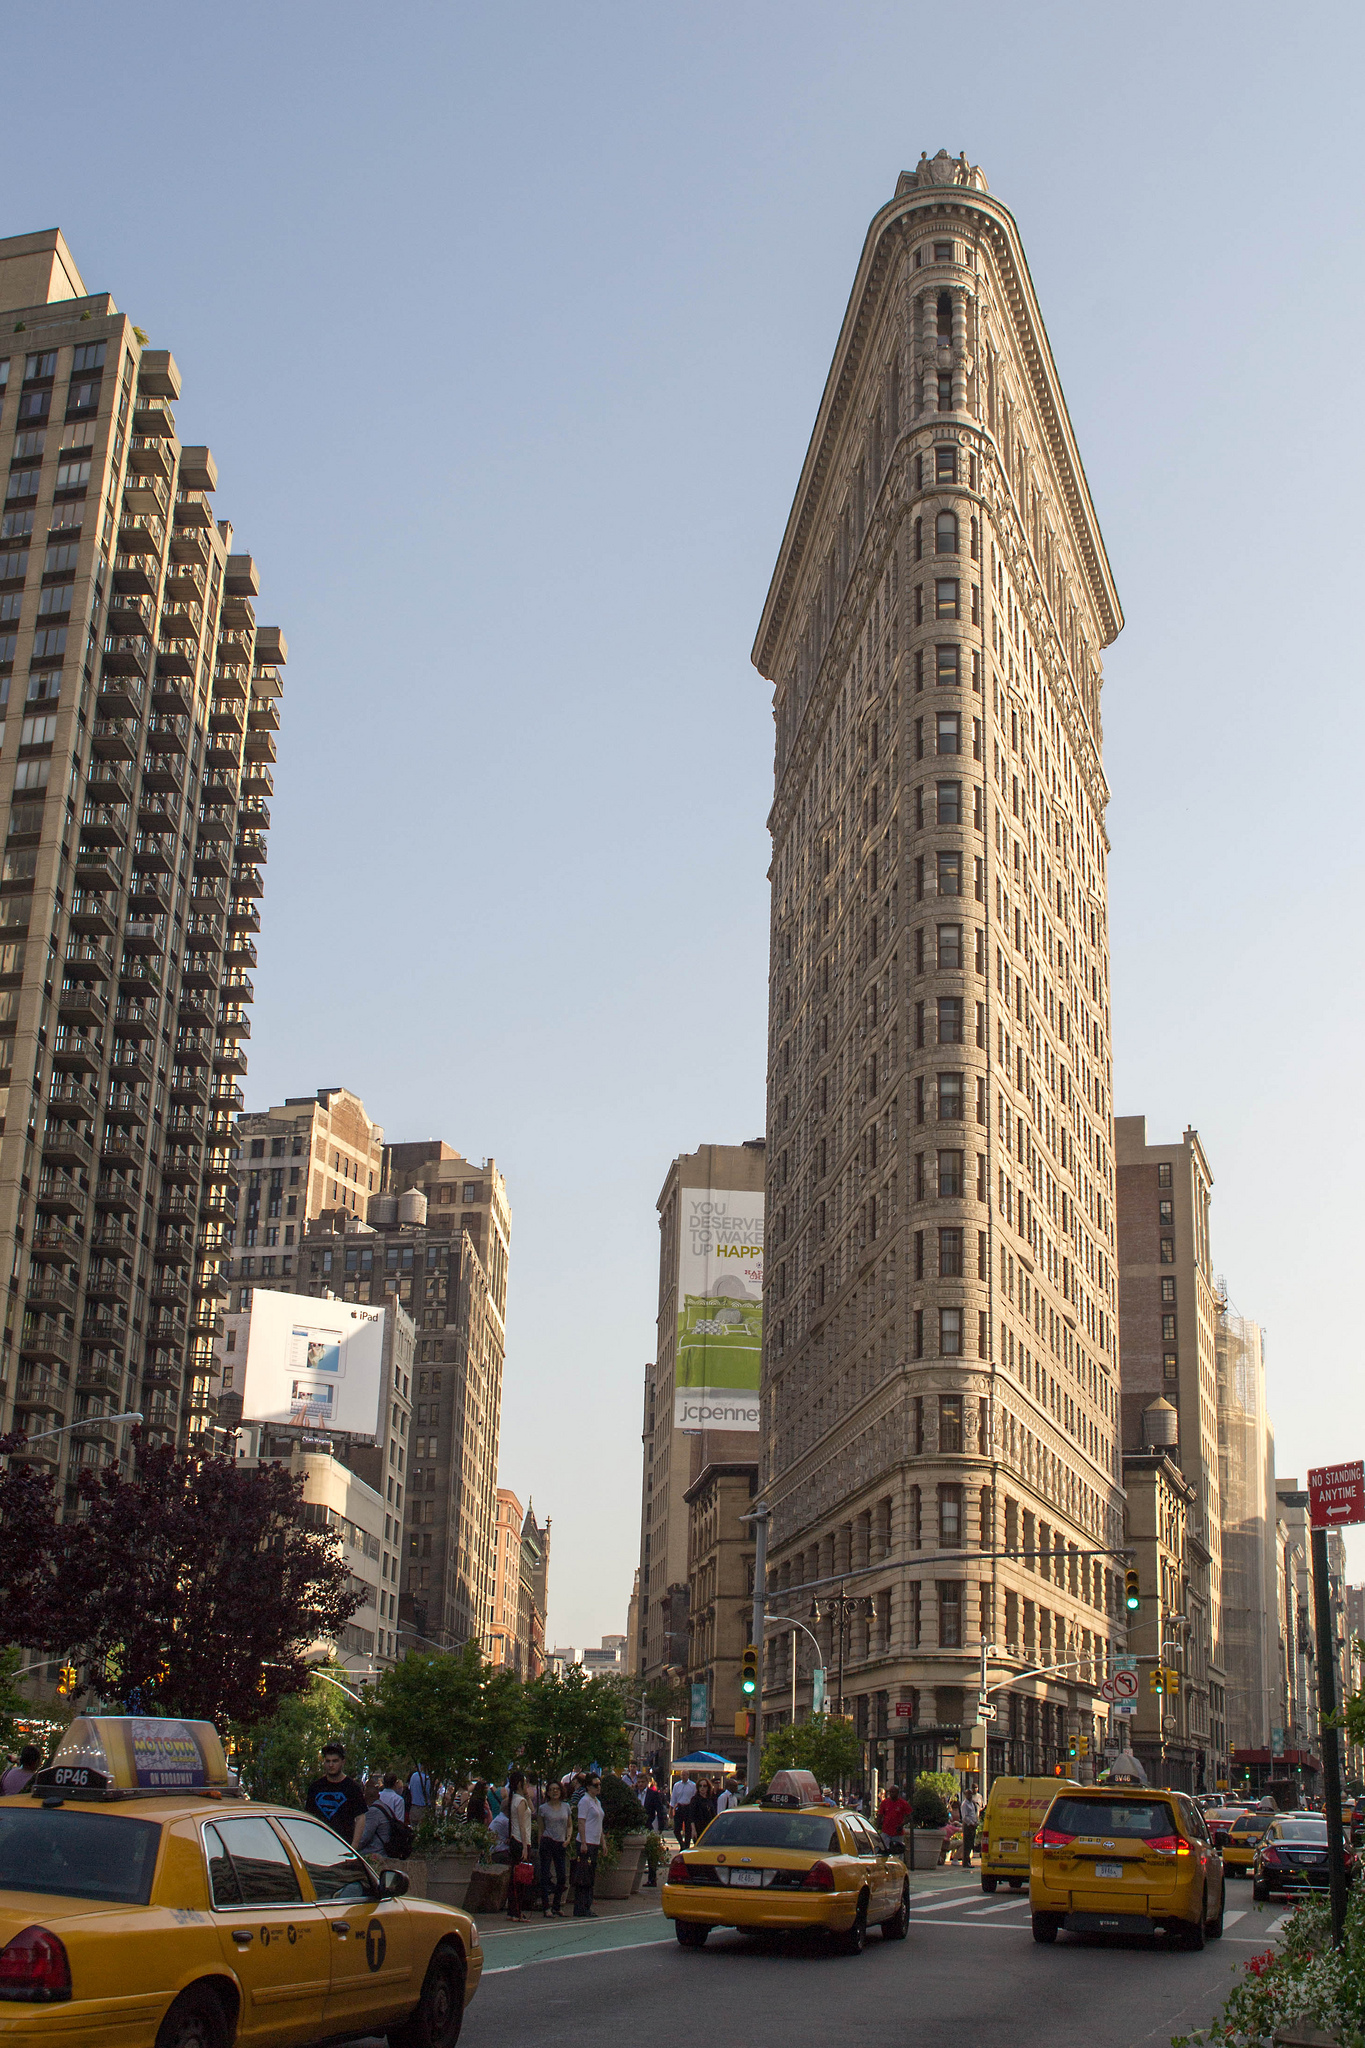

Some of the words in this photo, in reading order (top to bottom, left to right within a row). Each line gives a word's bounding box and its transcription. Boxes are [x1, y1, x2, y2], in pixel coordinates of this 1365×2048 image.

[691, 1201, 726, 1216] YOU
[689, 1215, 764, 1231] DESERVE
[689, 1229, 713, 1242] TO
[716, 1230, 764, 1245] WAKE
[692, 1243, 713, 1256] UP
[359, 1311, 379, 1322] iPad
[680, 1402, 760, 1424] jcpenne
[1311, 1474, 1323, 1488] NO
[1325, 1467, 1361, 1485] STANDING
[1319, 1485, 1357, 1502] ANYTIME
[133, 1736, 196, 1756] MOTOWN
[55, 1768, 89, 1786] 6P46
[150, 1773, 159, 1784] ON
[161, 1773, 193, 1785] BROADWAY
[771, 1794, 789, 1803] 4E48
